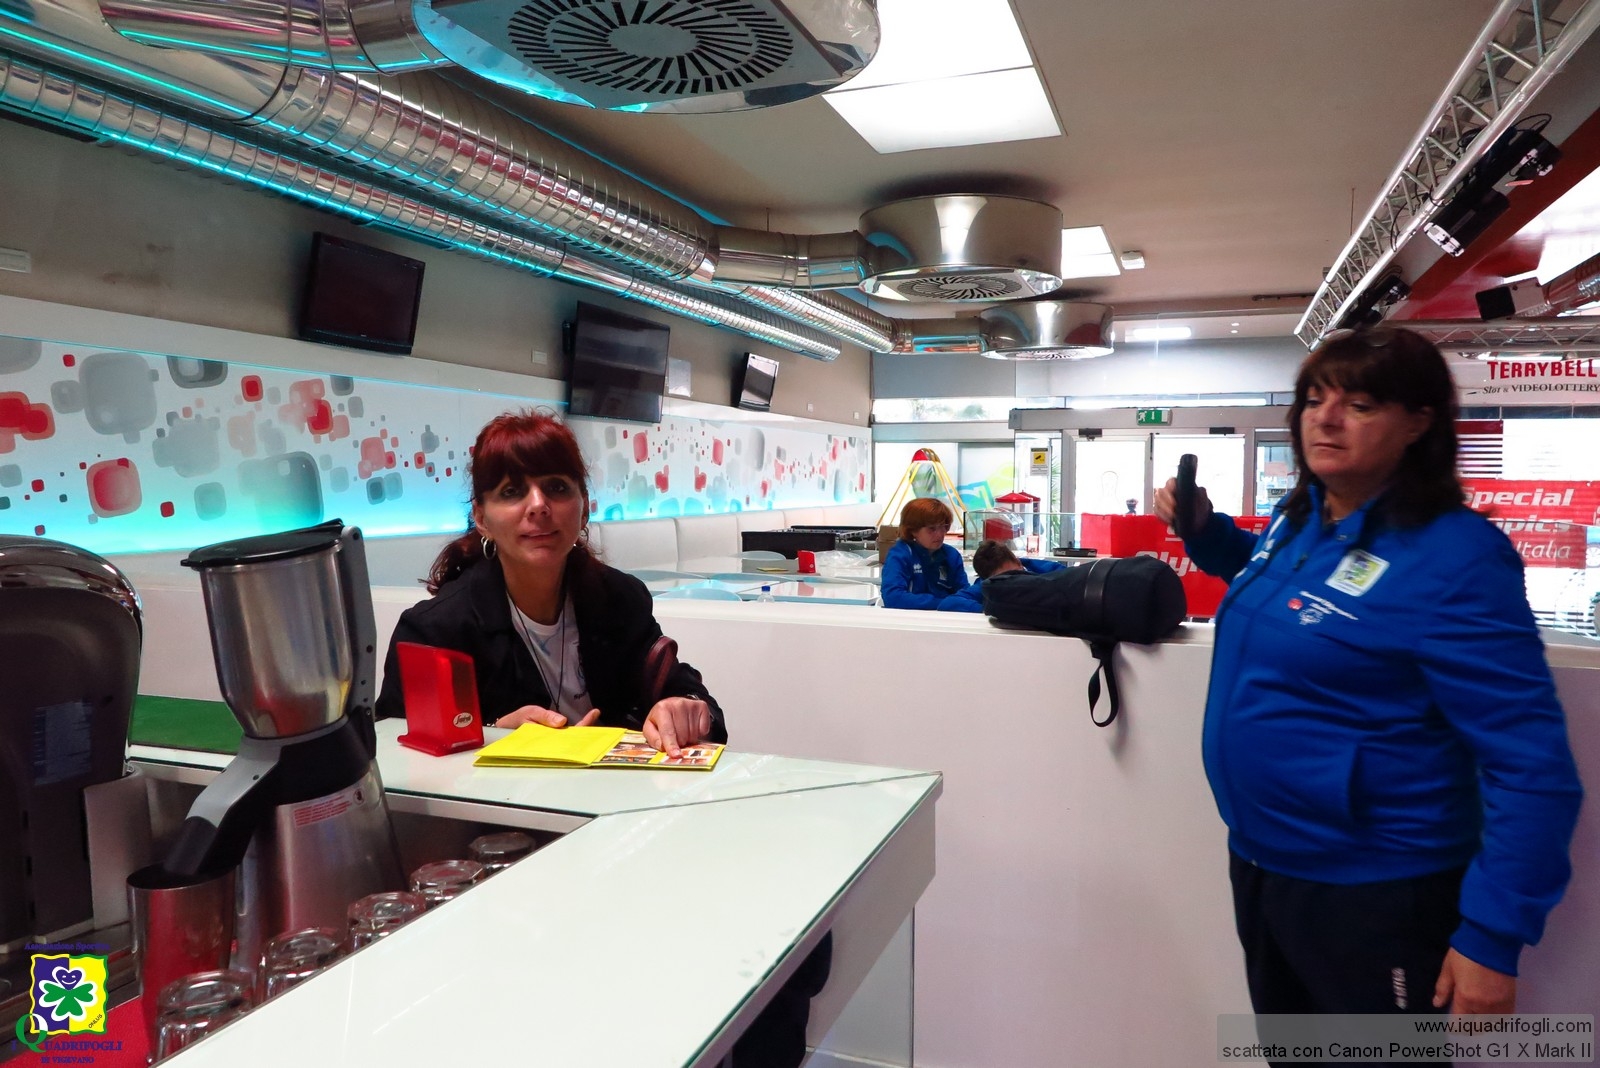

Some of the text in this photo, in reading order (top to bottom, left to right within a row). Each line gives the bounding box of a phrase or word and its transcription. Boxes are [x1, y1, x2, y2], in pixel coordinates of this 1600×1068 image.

[1487, 359, 1598, 380] TERRYBELL
[1482, 385, 1501, 395] Slot
[1511, 383, 1600, 393] VIDEOLOTTERY
